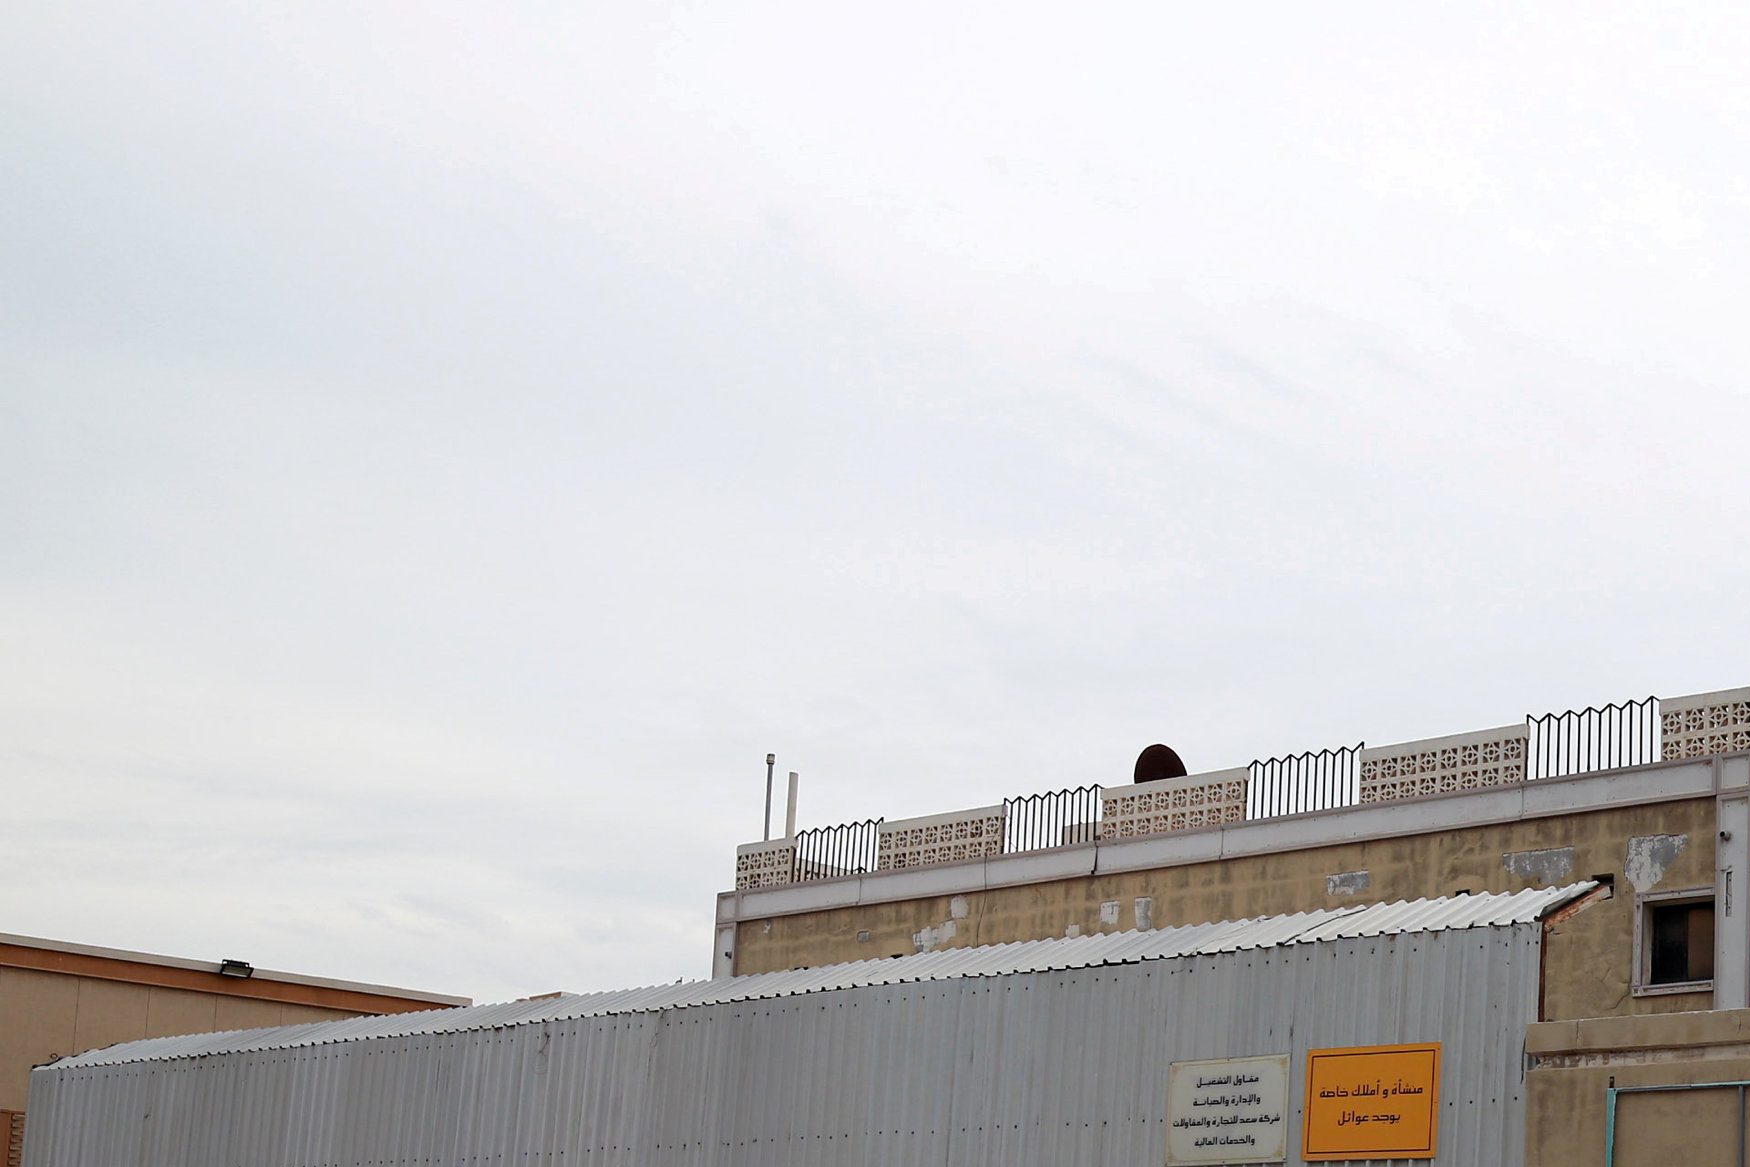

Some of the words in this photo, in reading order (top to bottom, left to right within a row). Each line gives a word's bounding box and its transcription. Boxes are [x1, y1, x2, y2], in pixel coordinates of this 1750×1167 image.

[1319, 1085, 1349, 1098] خاصة
[1351, 1079, 1380, 1097] أملاك
[1382, 1087, 1389, 1099] و
[1391, 1078, 1423, 1096] منشأة
[1337, 1110, 1369, 1126] عوائل
[1371, 1113, 1401, 1125] يوجد
